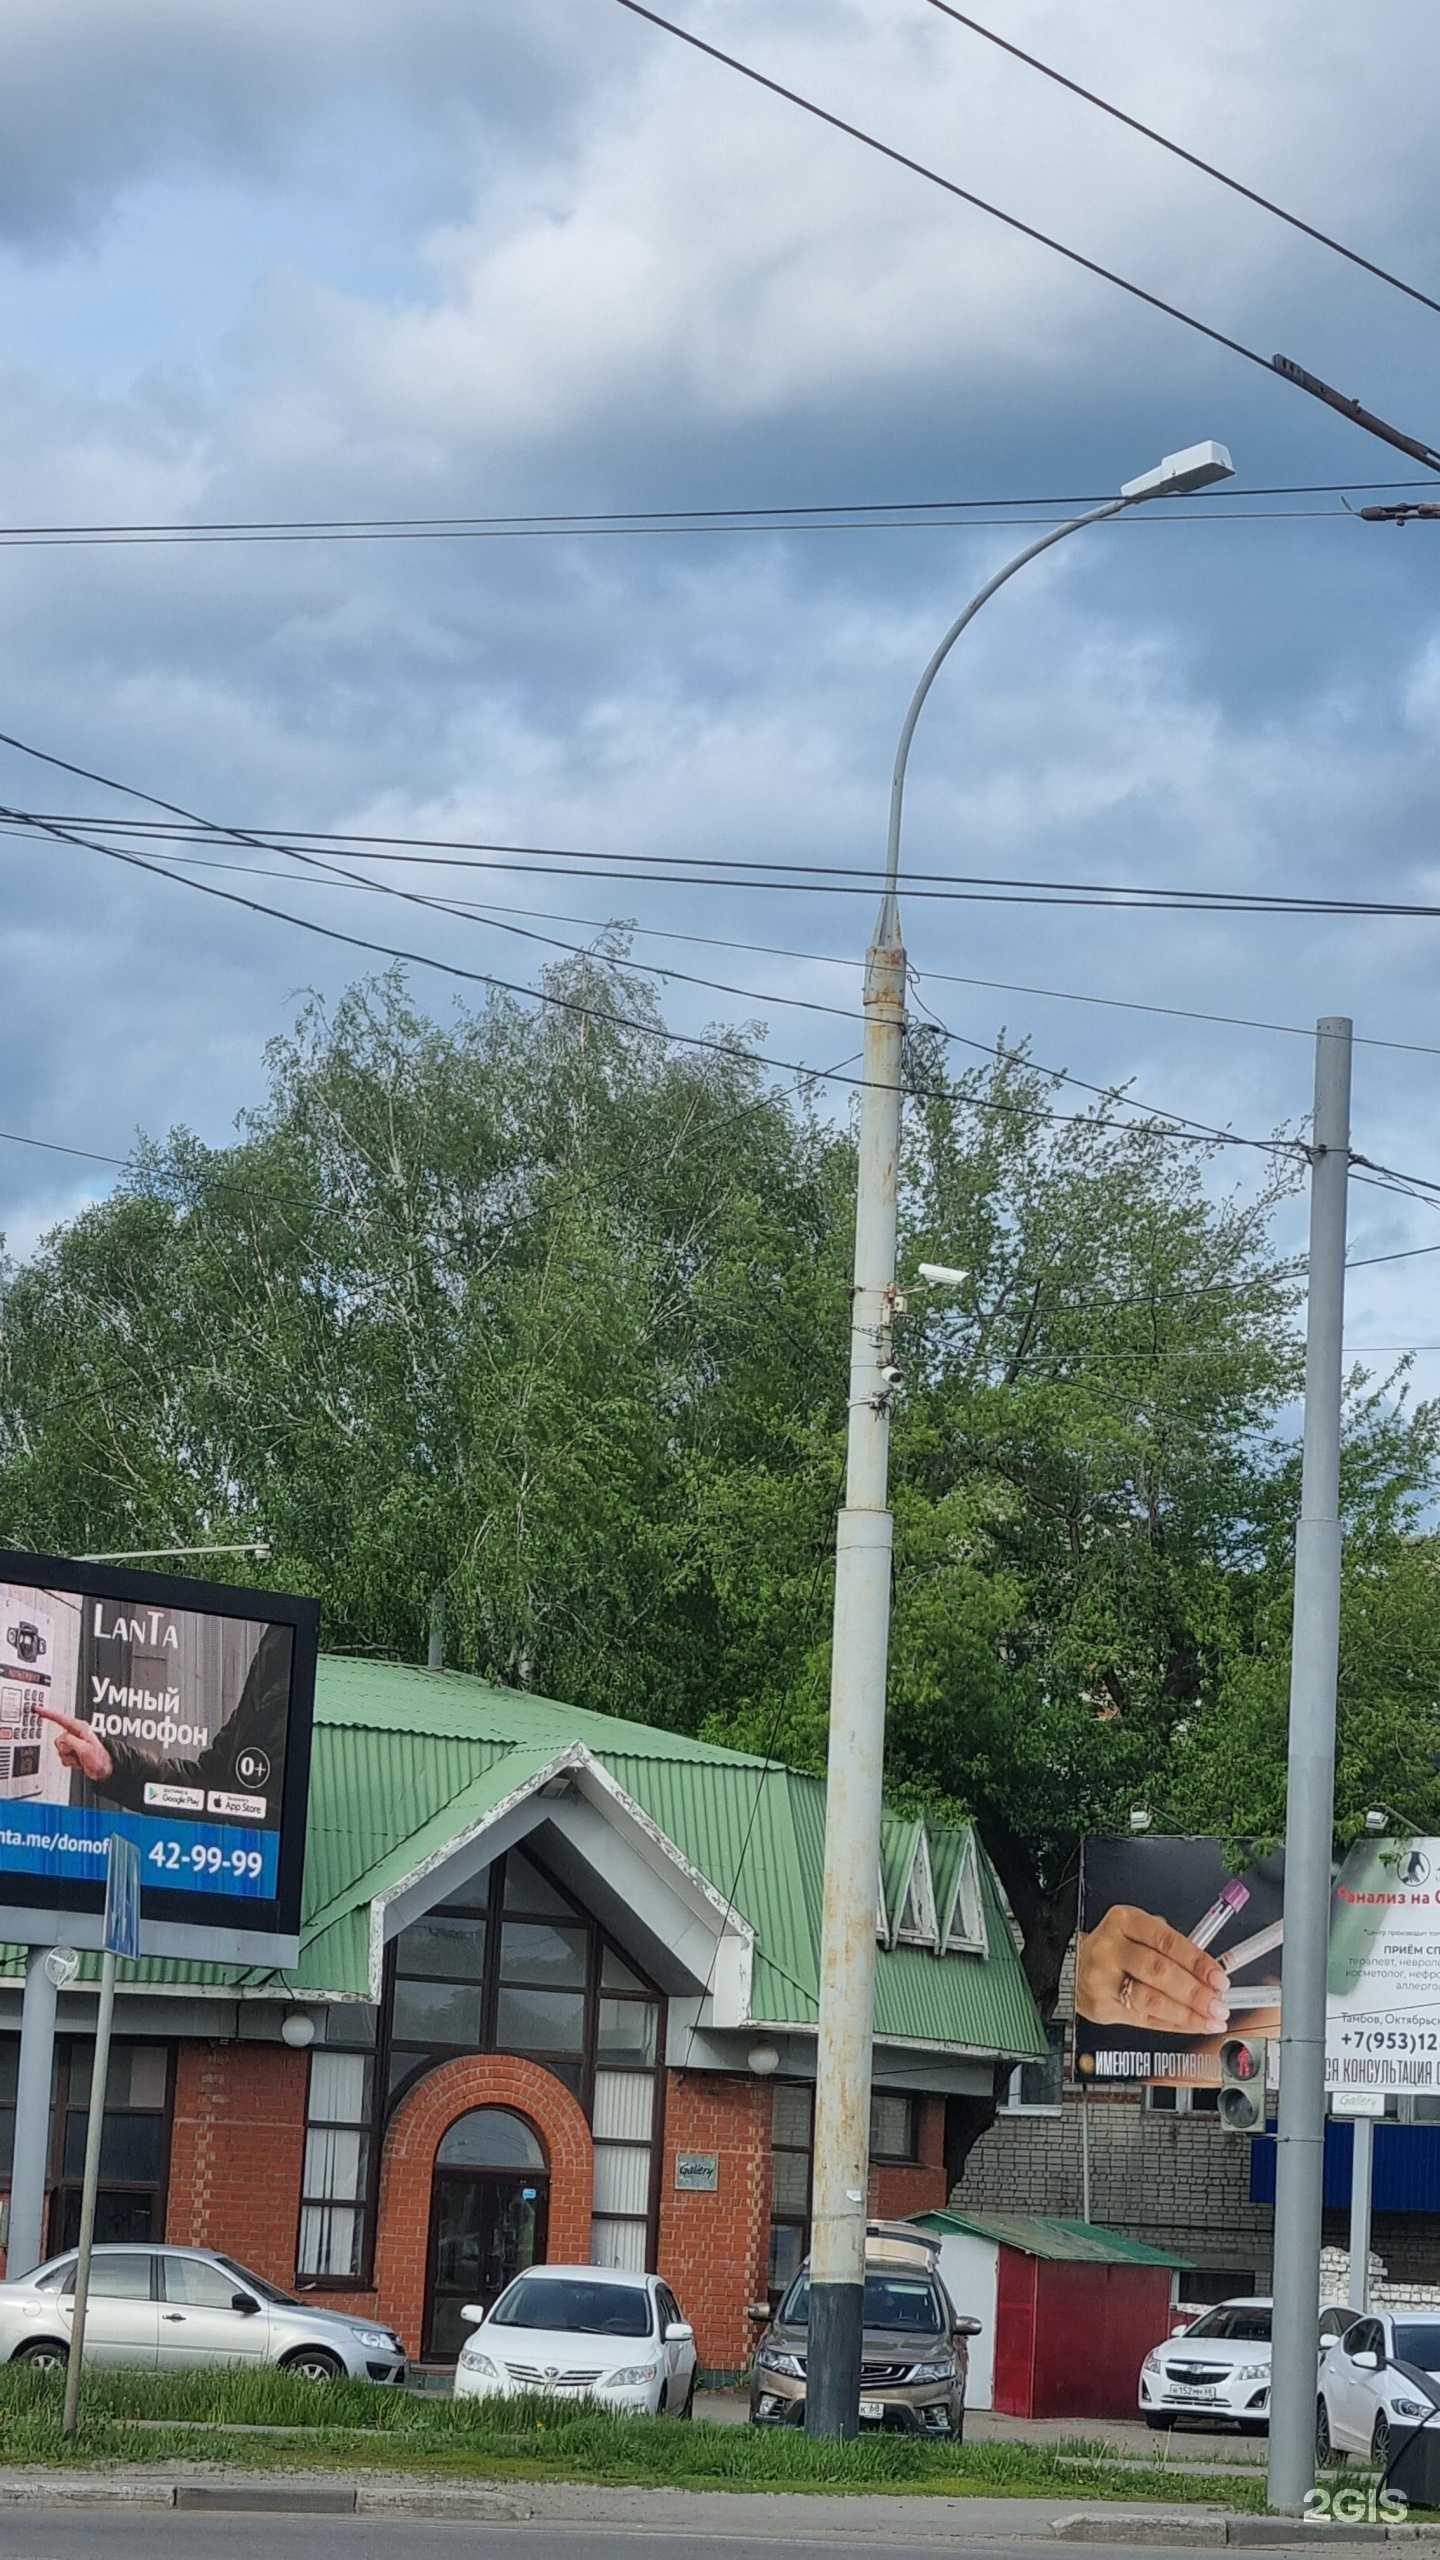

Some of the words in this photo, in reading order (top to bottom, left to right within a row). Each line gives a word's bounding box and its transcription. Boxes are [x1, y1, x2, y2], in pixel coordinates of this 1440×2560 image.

[91, 1675, 180, 1714] Умный
[90, 1712, 208, 1749] домофон
[240, 1756, 267, 1777] 0+
[162, 1793, 185, 1806] Google
[186, 1795, 200, 1808] Play
[225, 1801, 241, 1812] App
[242, 1802, 262, 1815] Store
[0, 1829, 111, 1855] nta.me/domof
[148, 1841, 263, 1878] 42-99-99
[1411, 1893, 1430, 1905] на
[1383, 1944, 1423, 1955] ПРИЁМ
[1395, 1982, 1440, 1992] аллерго
[1341, 2012, 1383, 2025] Тамбов,
[1095, 2050, 1151, 2076] ИМЕЮТСЯ
[1343, 2058, 1433, 2086] КОНСУЛЬТАЦИЯ
